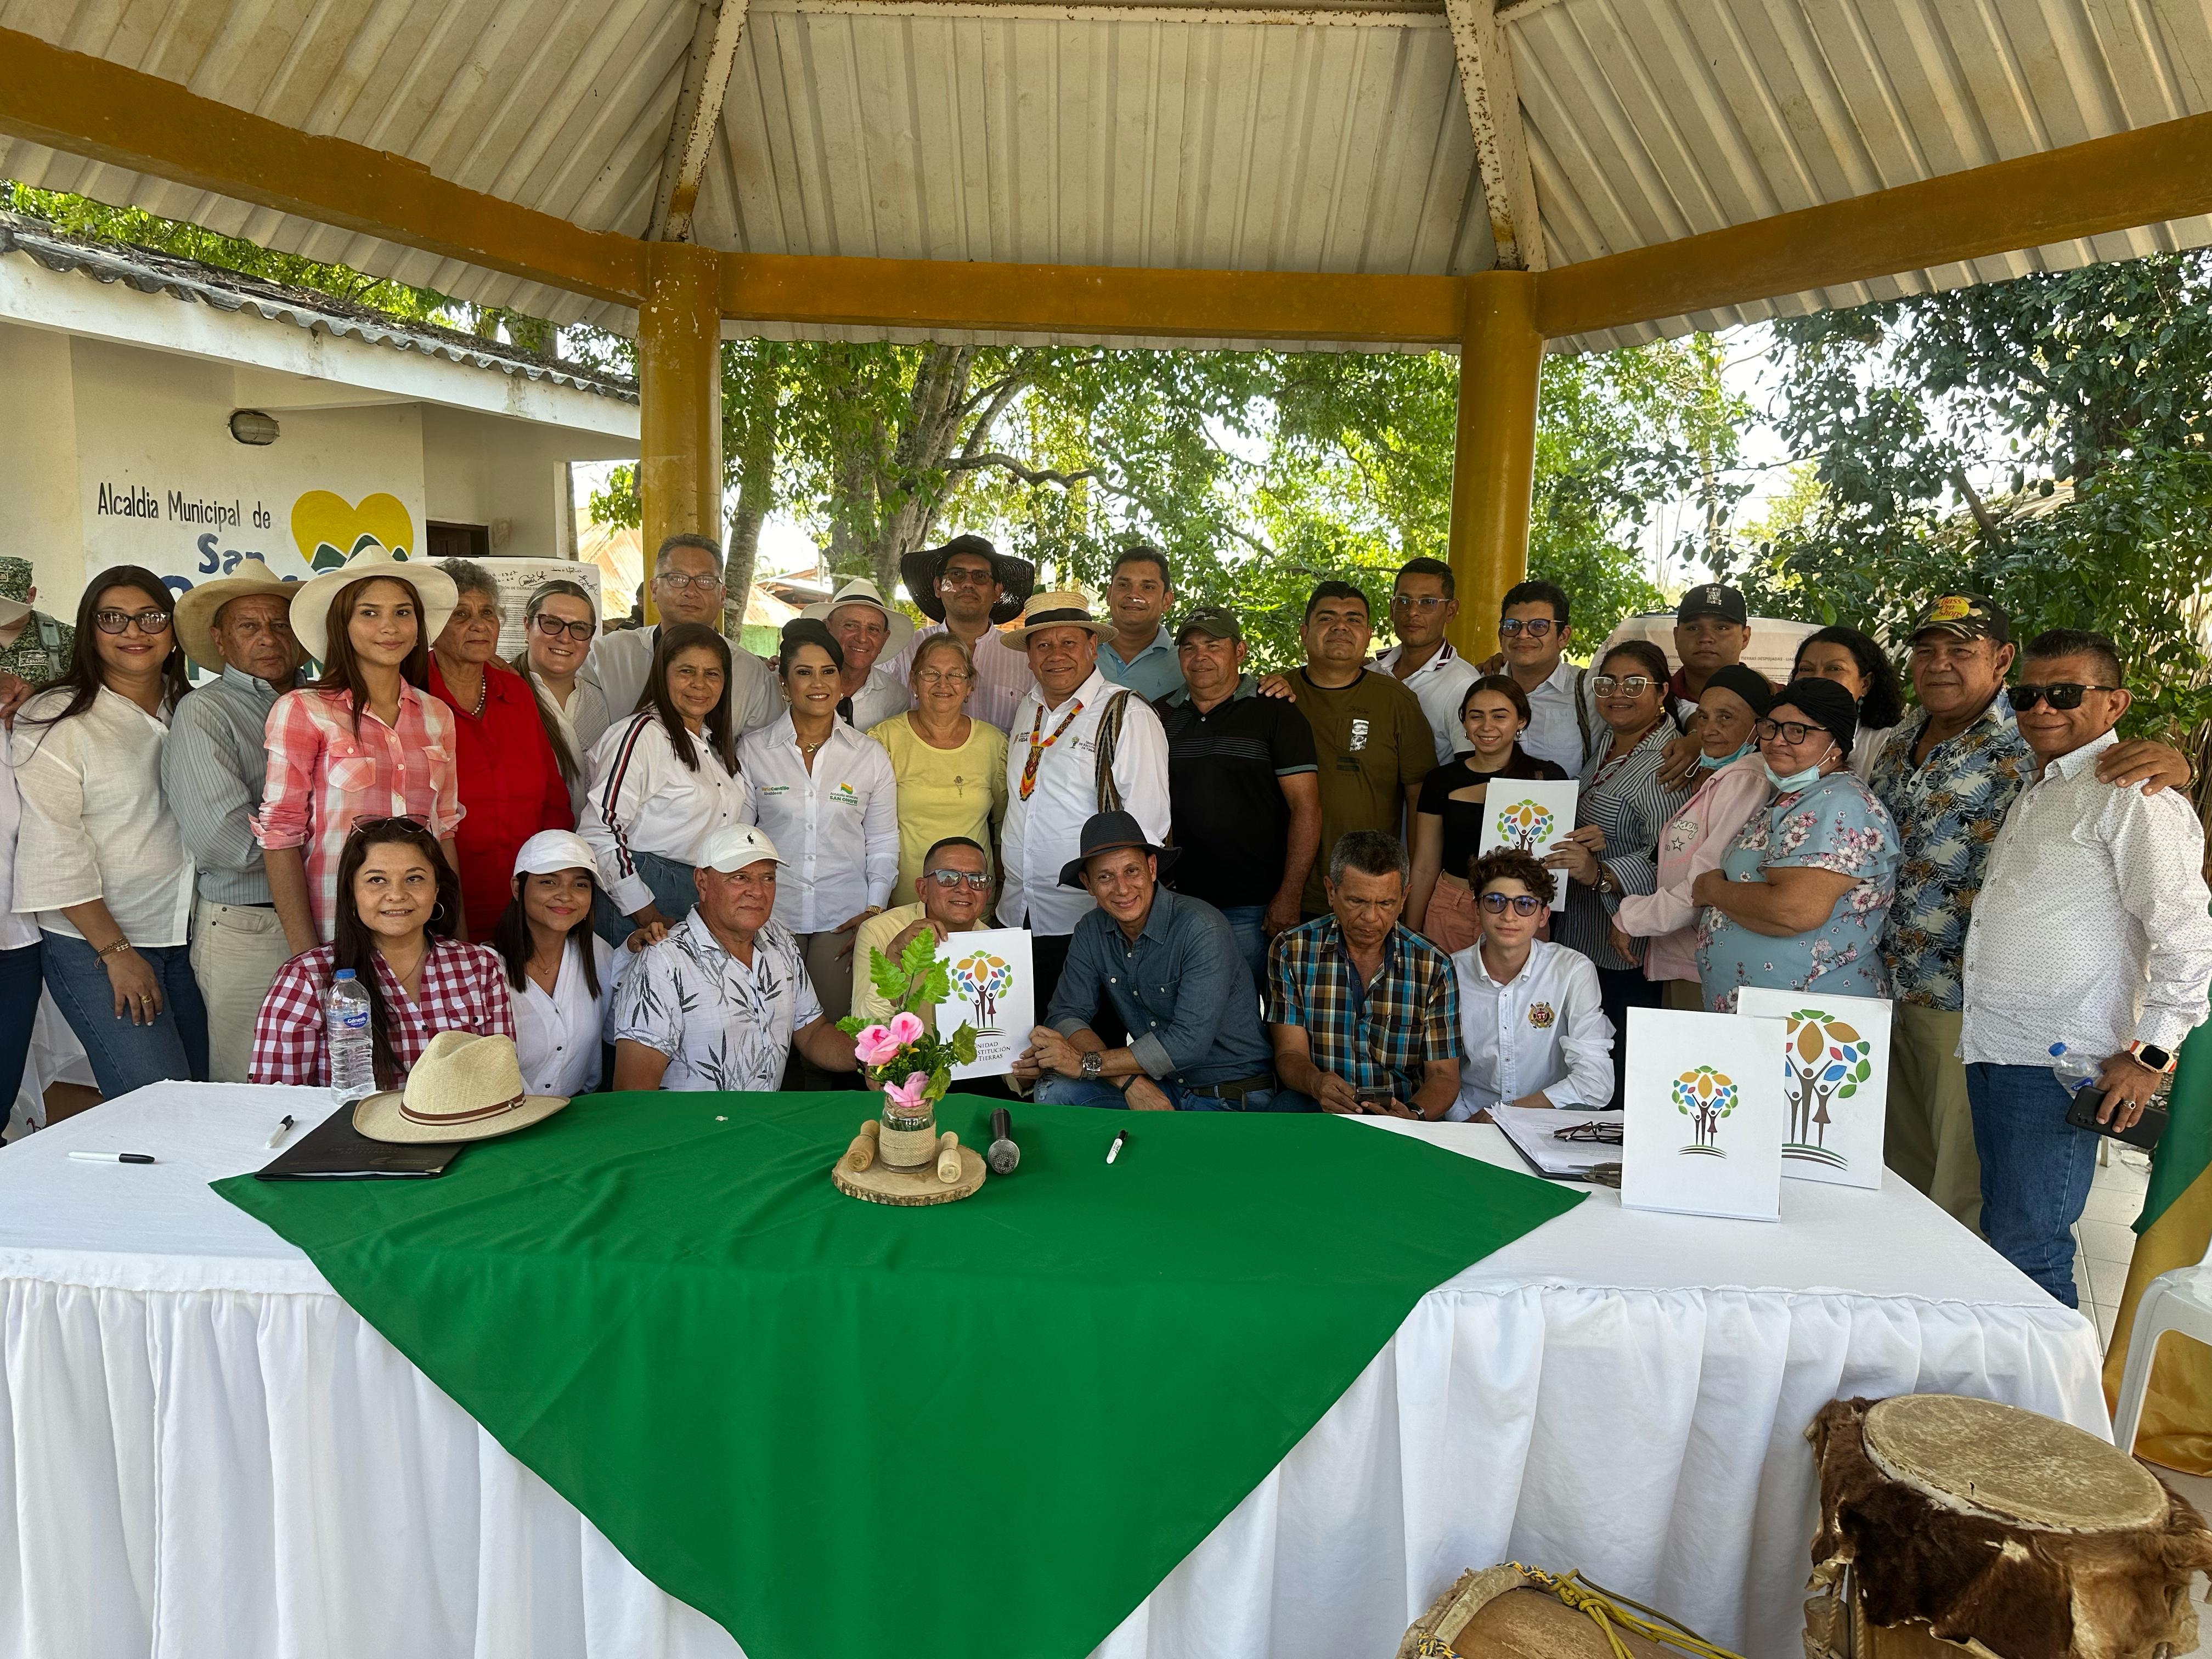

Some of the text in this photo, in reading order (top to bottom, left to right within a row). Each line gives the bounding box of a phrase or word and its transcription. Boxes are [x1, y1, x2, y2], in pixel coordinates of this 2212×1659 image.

[168, 490, 241, 532] Municipal
[253, 501, 271, 529] de
[978, 1046, 1011, 1055] STITUCIÓN
